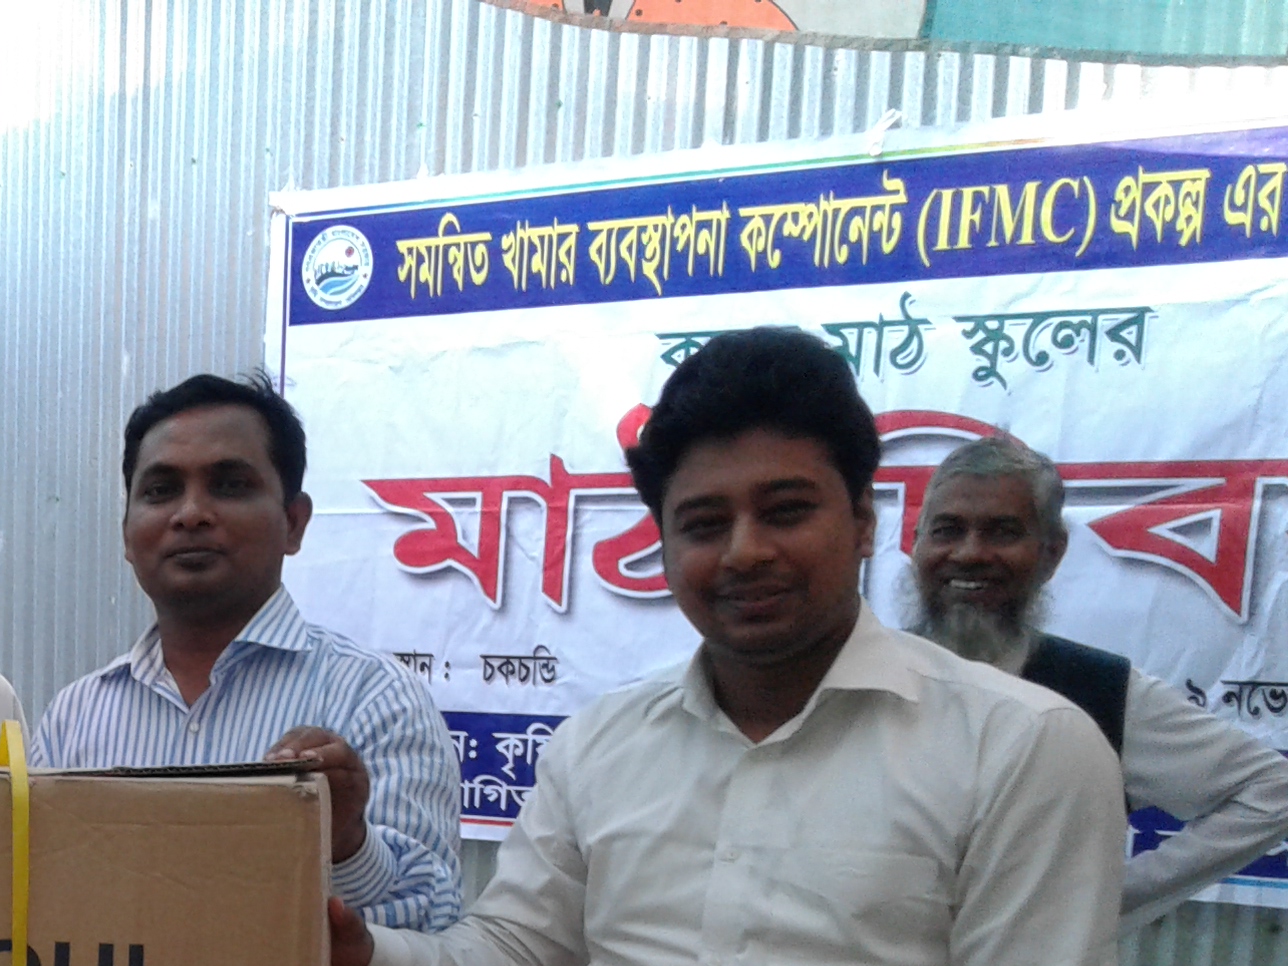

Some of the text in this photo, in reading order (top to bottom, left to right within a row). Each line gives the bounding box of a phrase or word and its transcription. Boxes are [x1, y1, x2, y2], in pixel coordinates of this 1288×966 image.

[396, 212, 493, 299] সমন্বিত
[500, 217, 580, 292] খামার
[587, 200, 731, 296] ব্যবস্থাপনা
[738, 170, 909, 273] কম্পোনেন্ট
[917, 176, 1098, 268] (IFMC)
[1110, 165, 1211, 251] প্রকল্প
[1223, 162, 1288, 238] এর
[954, 306, 1154, 391] স্কুলের
